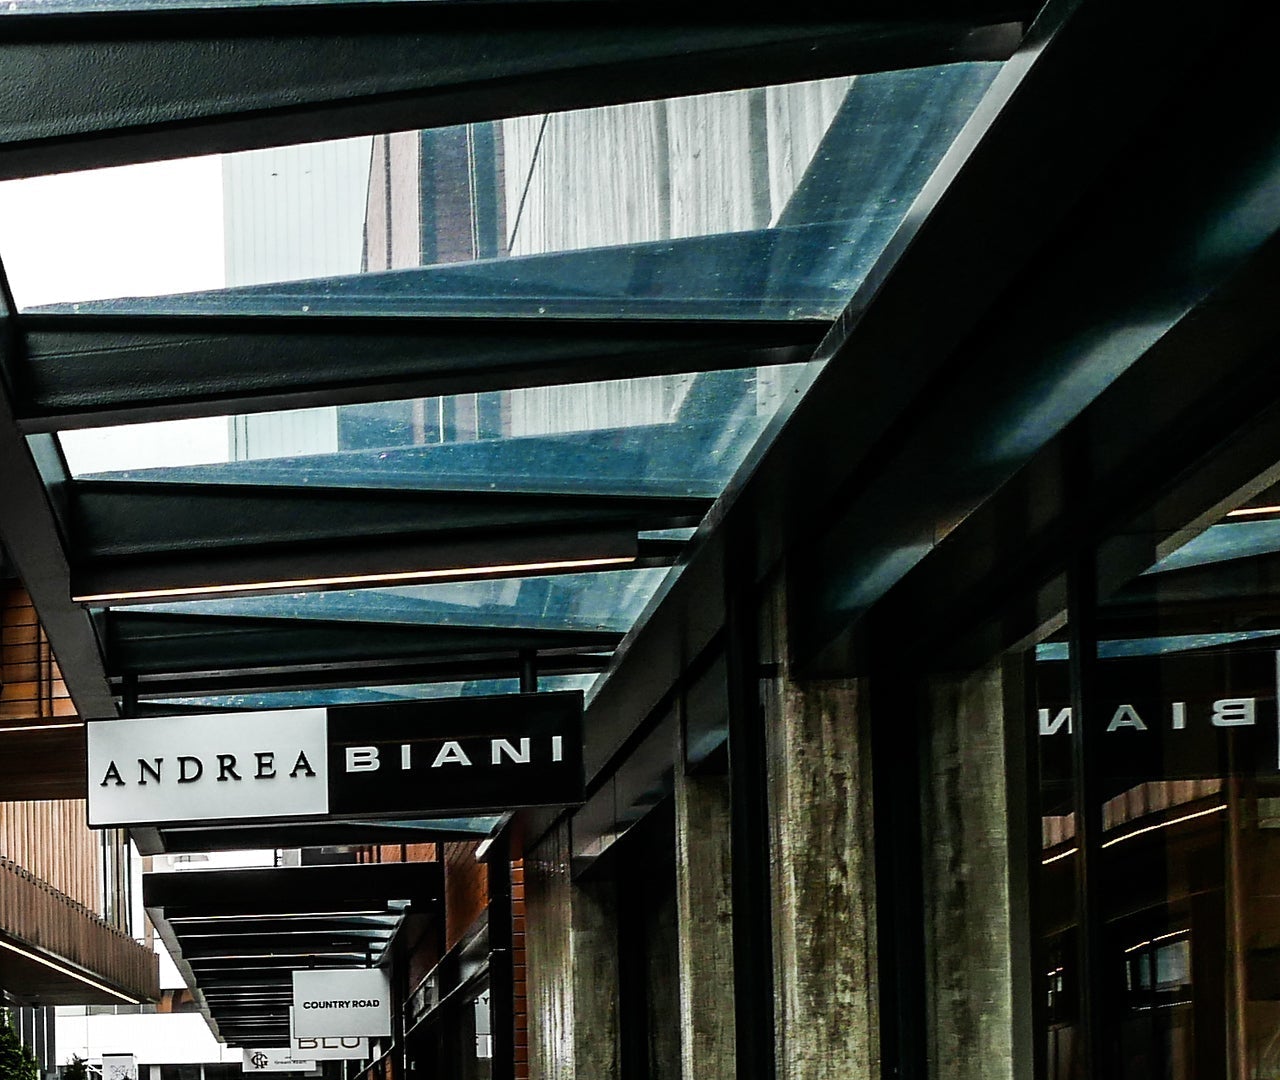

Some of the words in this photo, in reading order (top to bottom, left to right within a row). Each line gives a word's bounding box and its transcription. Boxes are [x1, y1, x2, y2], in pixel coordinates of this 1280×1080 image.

[100, 749, 317, 788] ANDREA
[345, 735, 563, 774] BIANI
[303, 1001, 350, 1010] COUNTRY
[352, 1000, 380, 1008] ROAD
